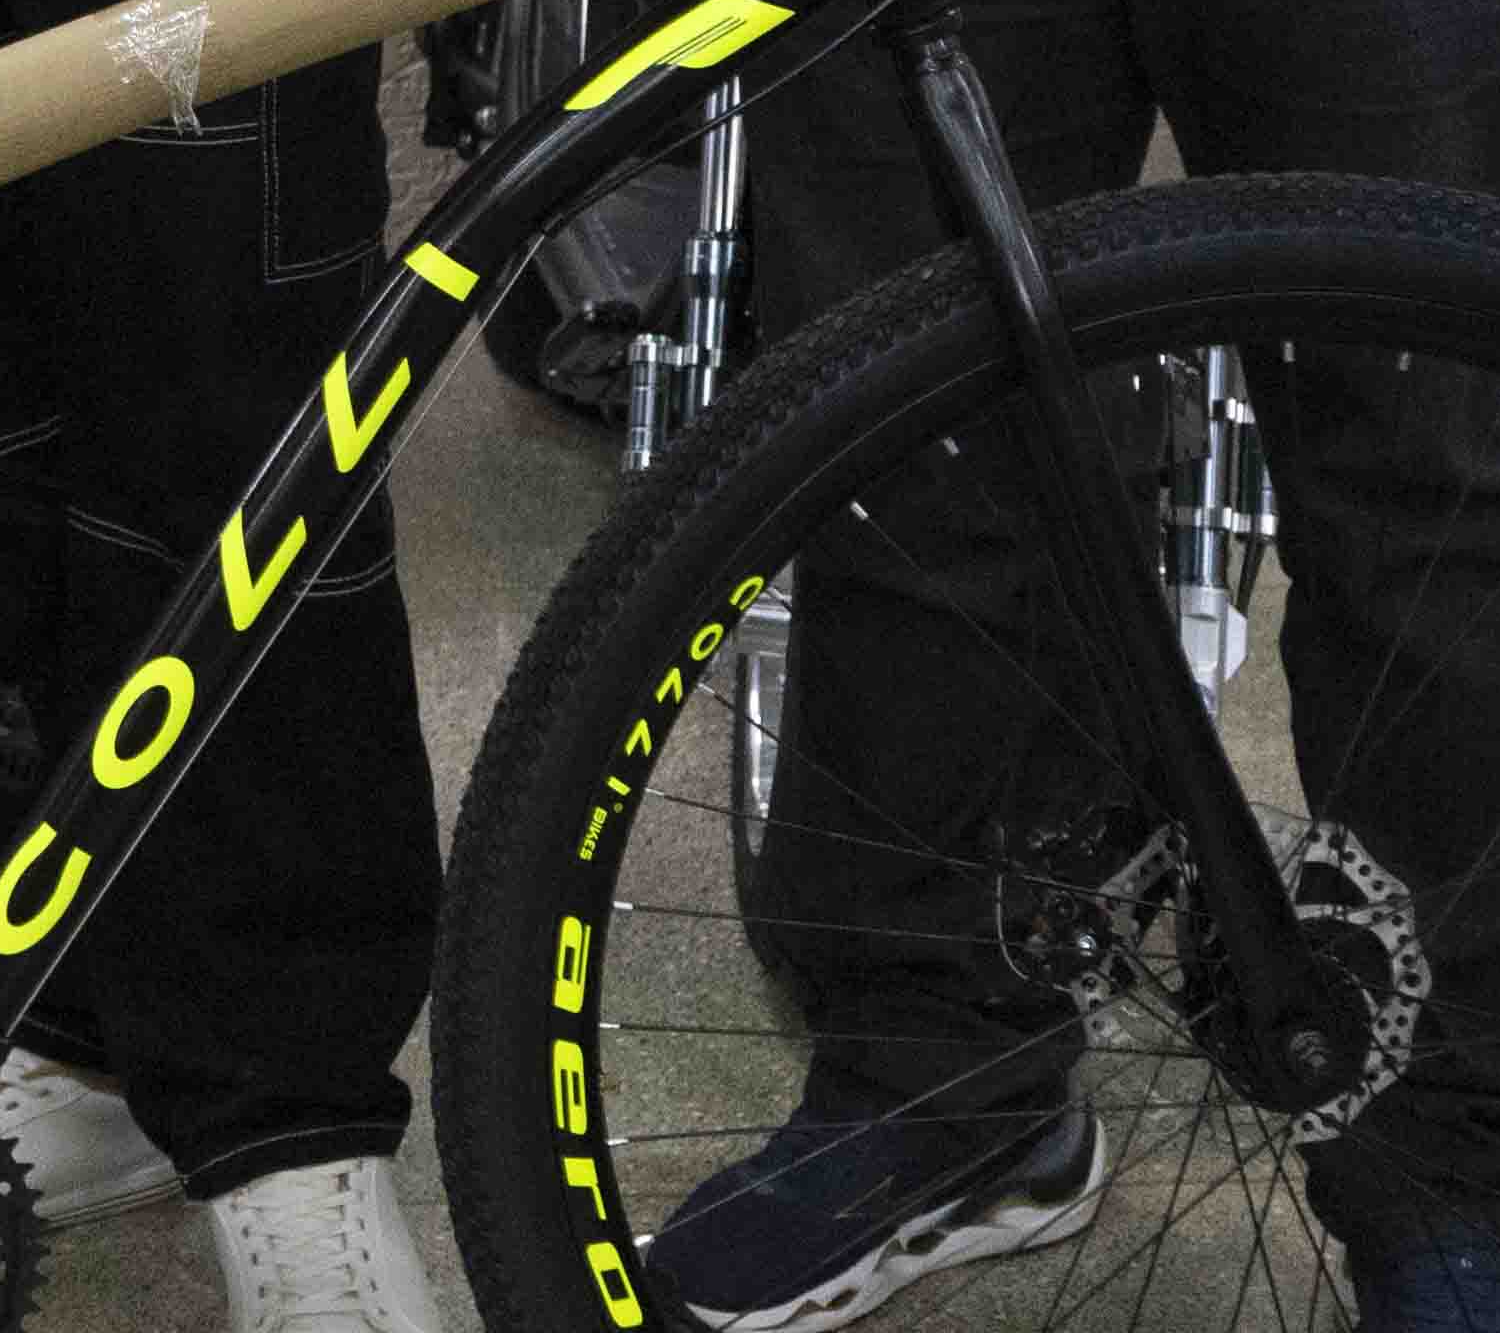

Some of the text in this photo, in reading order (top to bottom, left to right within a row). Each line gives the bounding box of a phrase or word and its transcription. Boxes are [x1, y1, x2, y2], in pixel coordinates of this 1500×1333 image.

[607, 574, 766, 799] COLLI
[579, 805, 608, 862] BIKES
[552, 916, 645, 1330] aero
